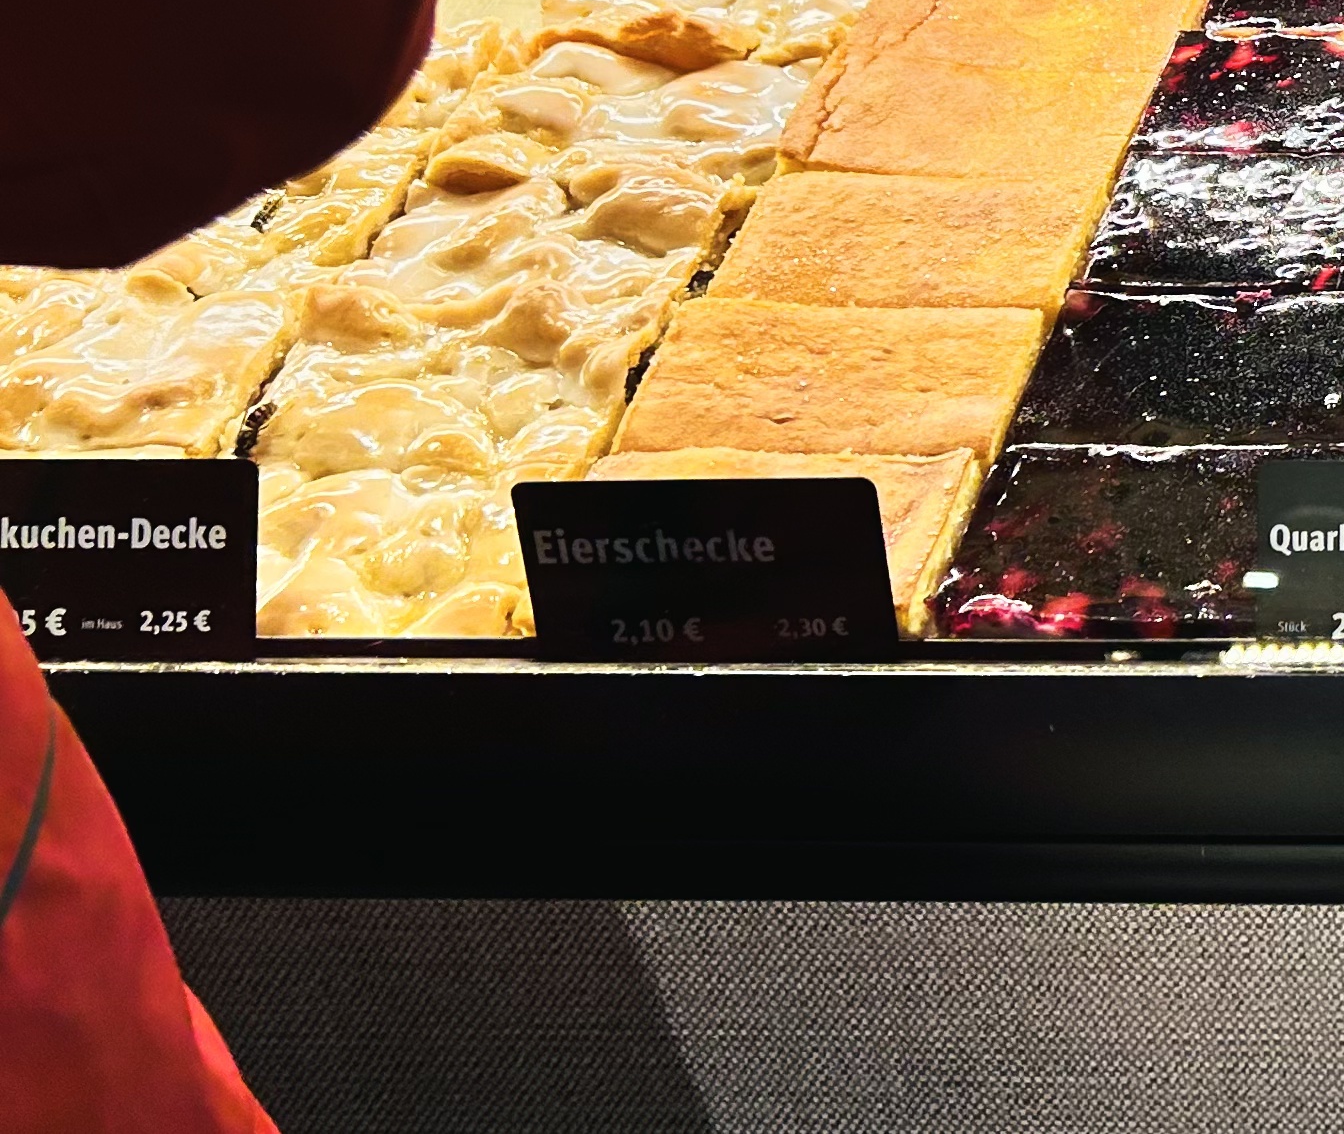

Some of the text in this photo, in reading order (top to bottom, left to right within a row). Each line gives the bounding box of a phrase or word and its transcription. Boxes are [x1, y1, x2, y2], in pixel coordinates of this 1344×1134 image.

[532, 527, 775, 565] Eierschecke
[44, 607, 67, 637] €
[81, 618, 95, 630] im
[97, 618, 124, 631] Haus
[139, 610, 188, 635] 2,25
[193, 609, 211, 633] €
[610, 617, 705, 645] 2,10 €
[777, 616, 849, 640] 2,30 €
